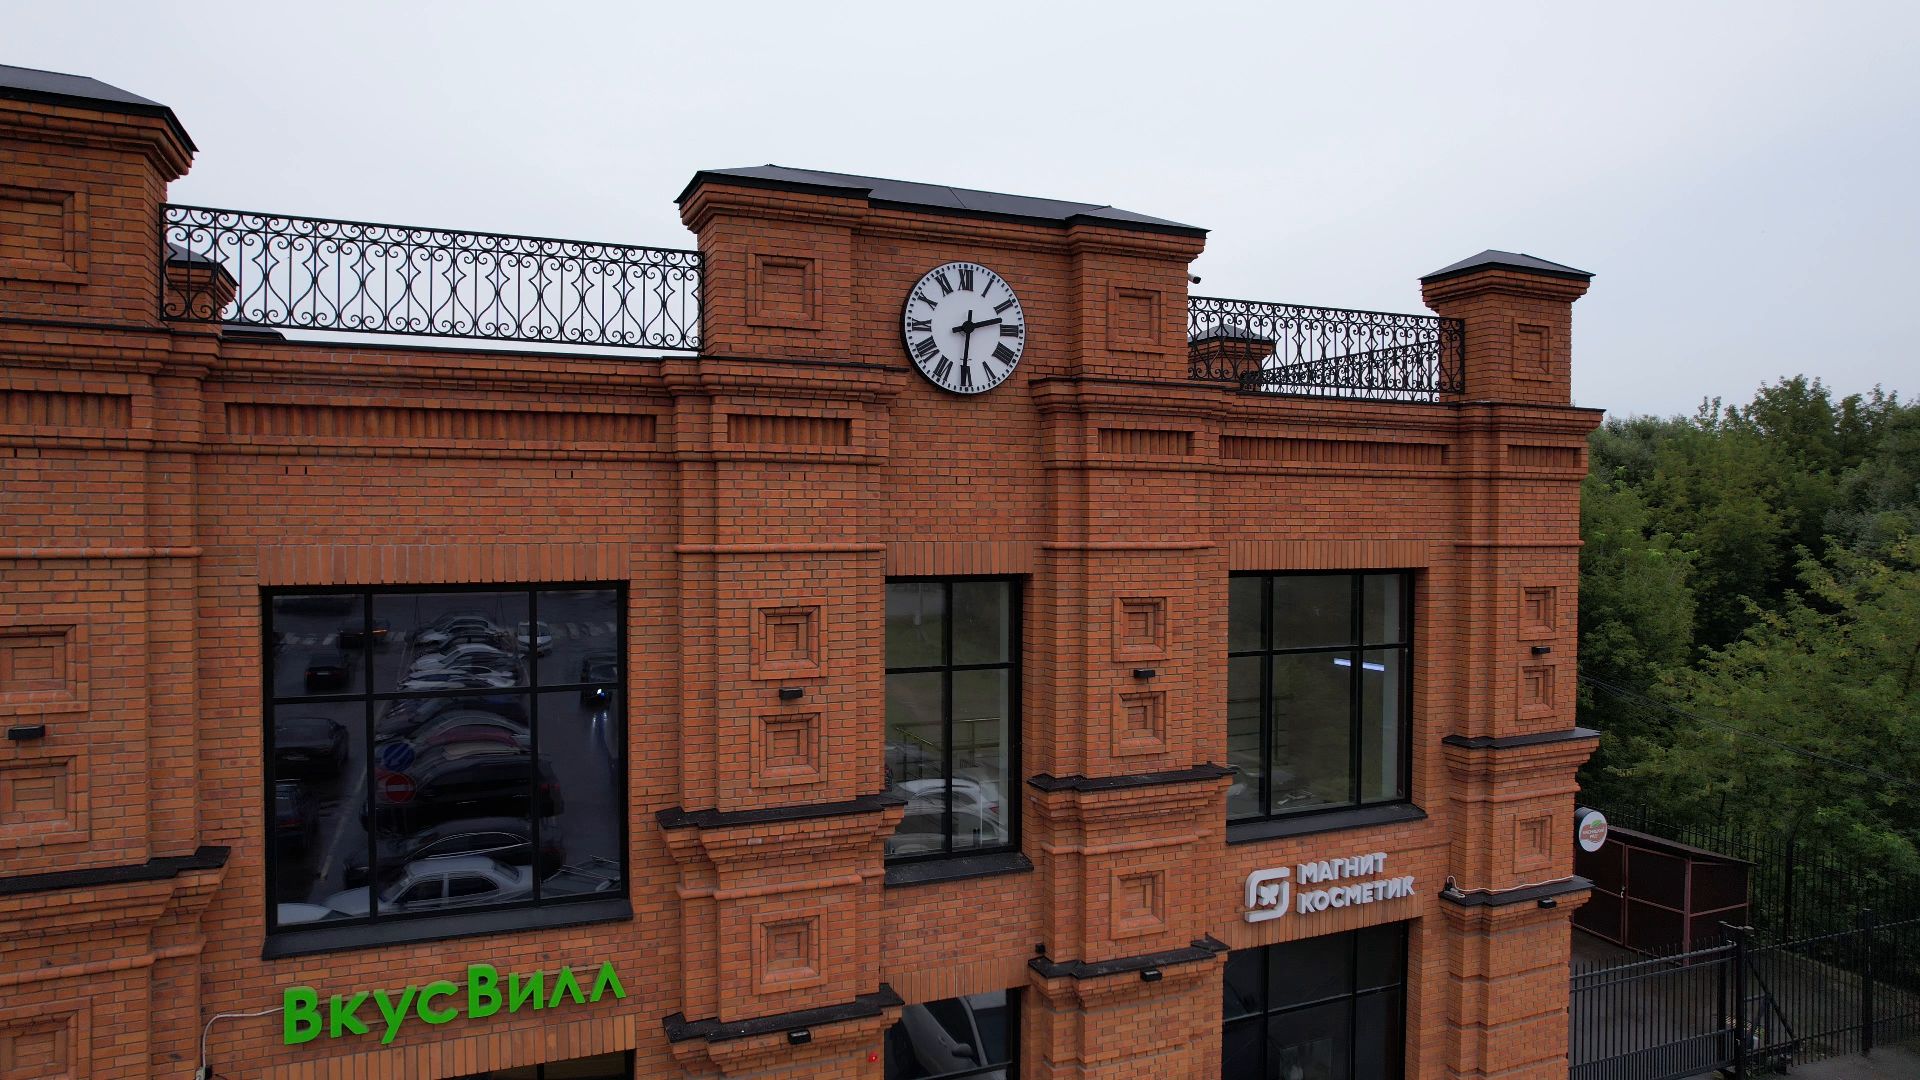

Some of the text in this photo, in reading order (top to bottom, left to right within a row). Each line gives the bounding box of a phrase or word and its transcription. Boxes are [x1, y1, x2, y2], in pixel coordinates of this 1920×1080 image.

[934, 273, 954, 297] XI
[958, 269, 974, 291] XII
[981, 278, 994, 298] I
[917, 291, 938, 311] X
[993, 298, 1014, 315] II
[911, 318, 932, 332] IX
[1000, 324, 1019, 337] III
[915, 335, 940, 364] VIII
[933, 354, 953, 382] VII
[982, 361, 997, 382] V
[1297, 852, 1388, 885] МАГНИТ
[1297, 875, 1416, 915] КОСМЕТИК
[283, 960, 627, 1045] ВкусВилл
